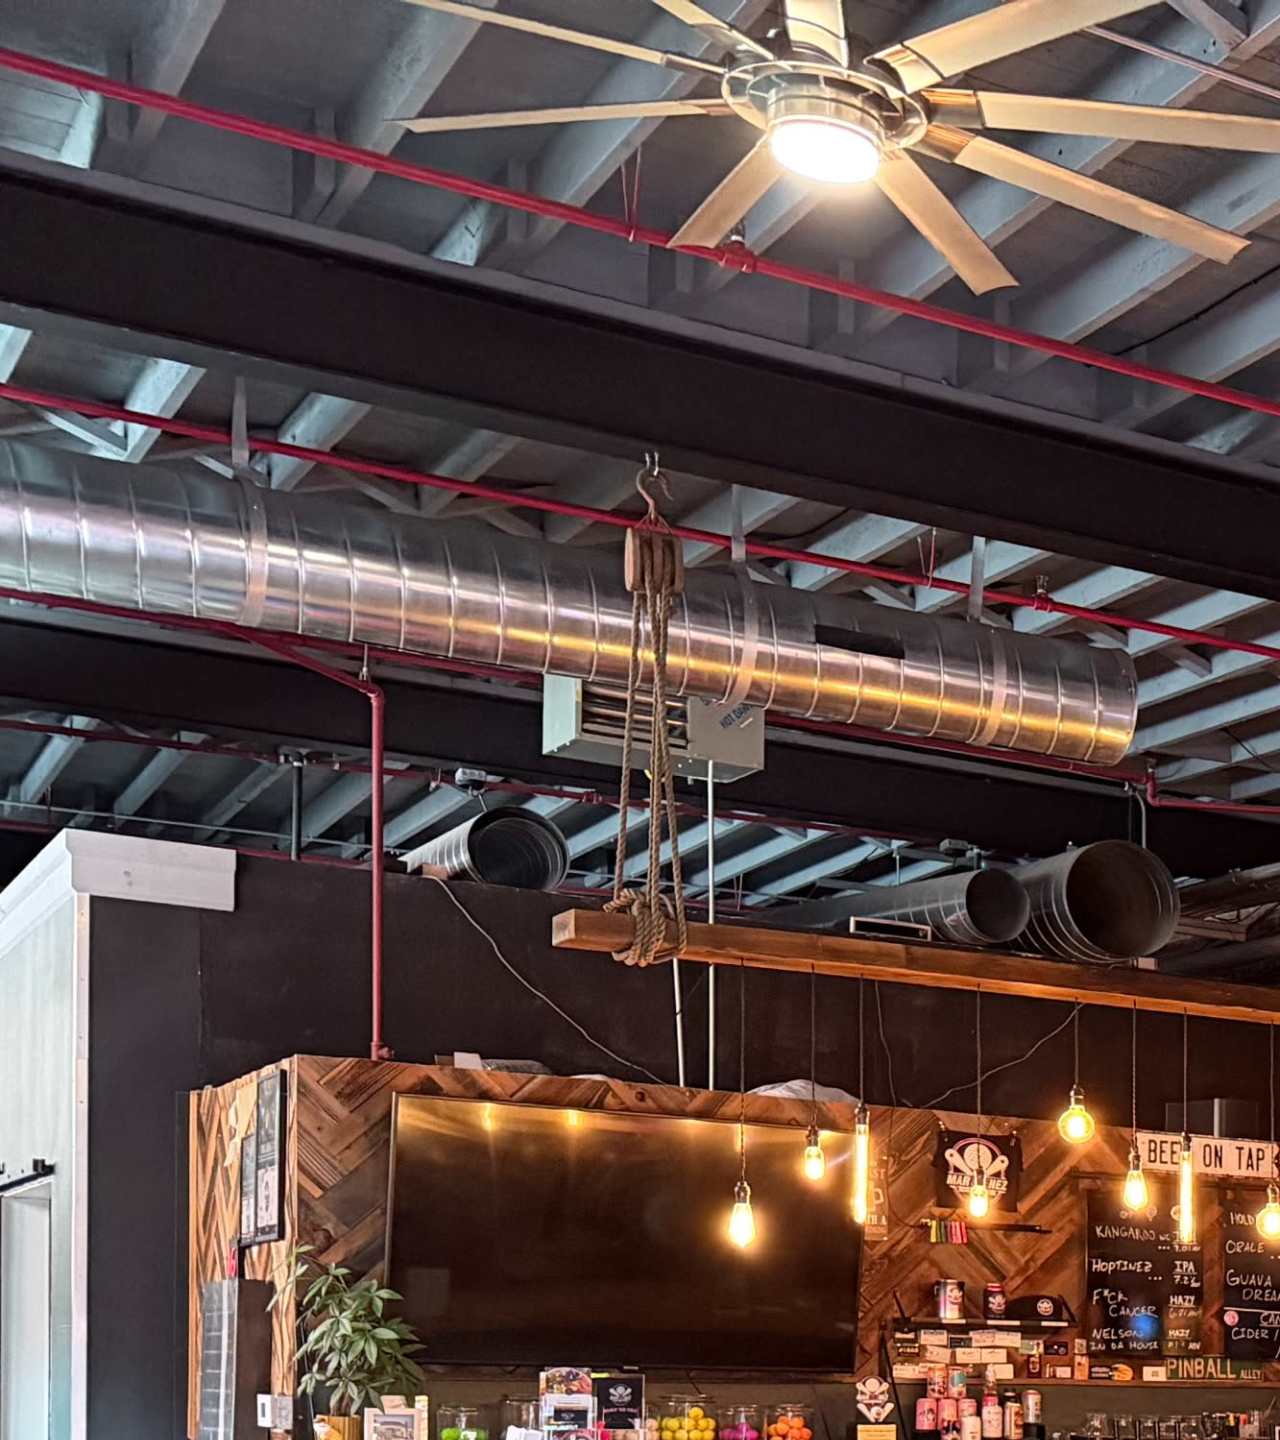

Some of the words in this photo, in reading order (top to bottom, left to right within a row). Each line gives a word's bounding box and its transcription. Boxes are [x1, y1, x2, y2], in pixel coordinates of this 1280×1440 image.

[1148, 1139, 1188, 1165] BEE
[1203, 1144, 1222, 1169] ON
[1235, 1146, 1265, 1171] TAP
[1095, 1225, 1156, 1241] KANGAROO
[1173, 1261, 1195, 1273] IPA
[1226, 1269, 1272, 1287] GUAVA
[1169, 1295, 1195, 1305] HAZY
[1092, 1328, 1145, 1340] NELSON
[1232, 1328, 1269, 1340] CIDER
[1167, 1358, 1236, 1379] PINBALL
[1240, 1369, 1261, 1379] ALLEY
